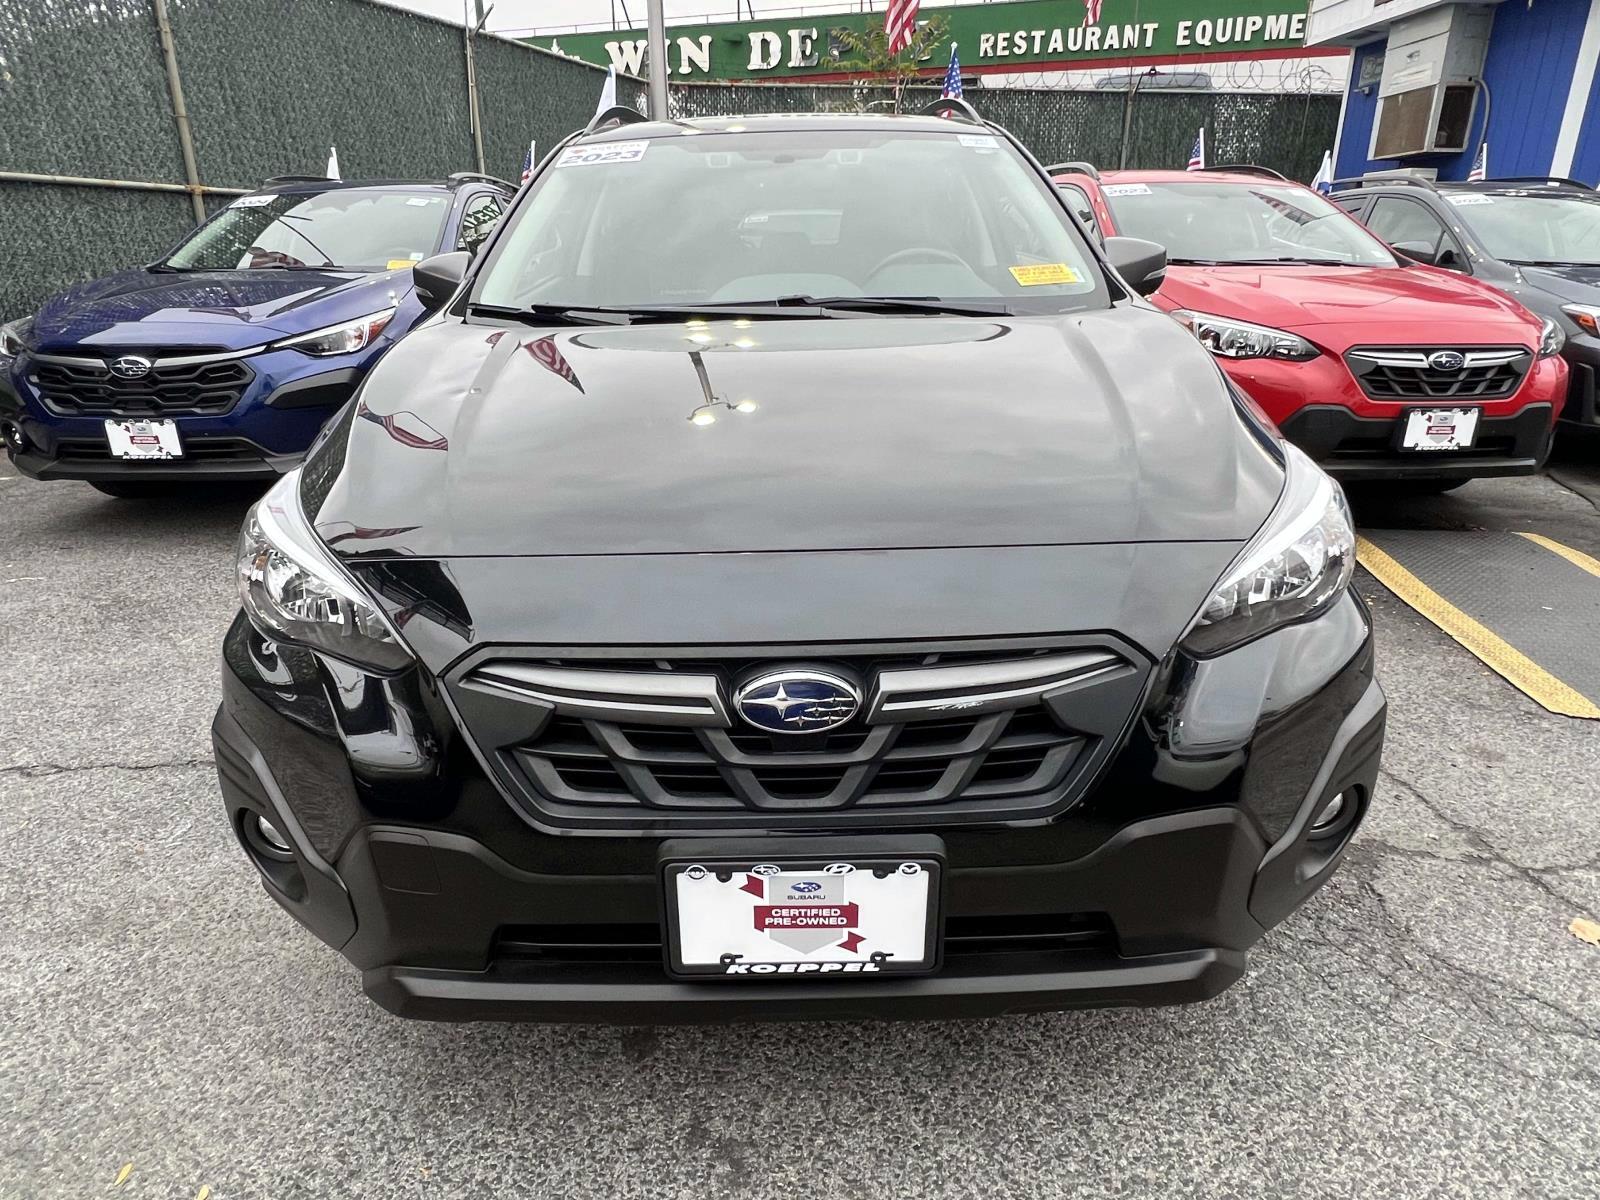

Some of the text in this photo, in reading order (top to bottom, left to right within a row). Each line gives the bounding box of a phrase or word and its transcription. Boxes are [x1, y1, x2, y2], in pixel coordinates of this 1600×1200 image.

[979, 13, 1306, 58] RESTAURANT EQUIPME
[560, 150, 642, 165] 2023
[771, 908, 841, 917] CERTIFIED
[764, 916, 848, 926] PRE-OWNED
[725, 962, 880, 974] KOEPPEL
